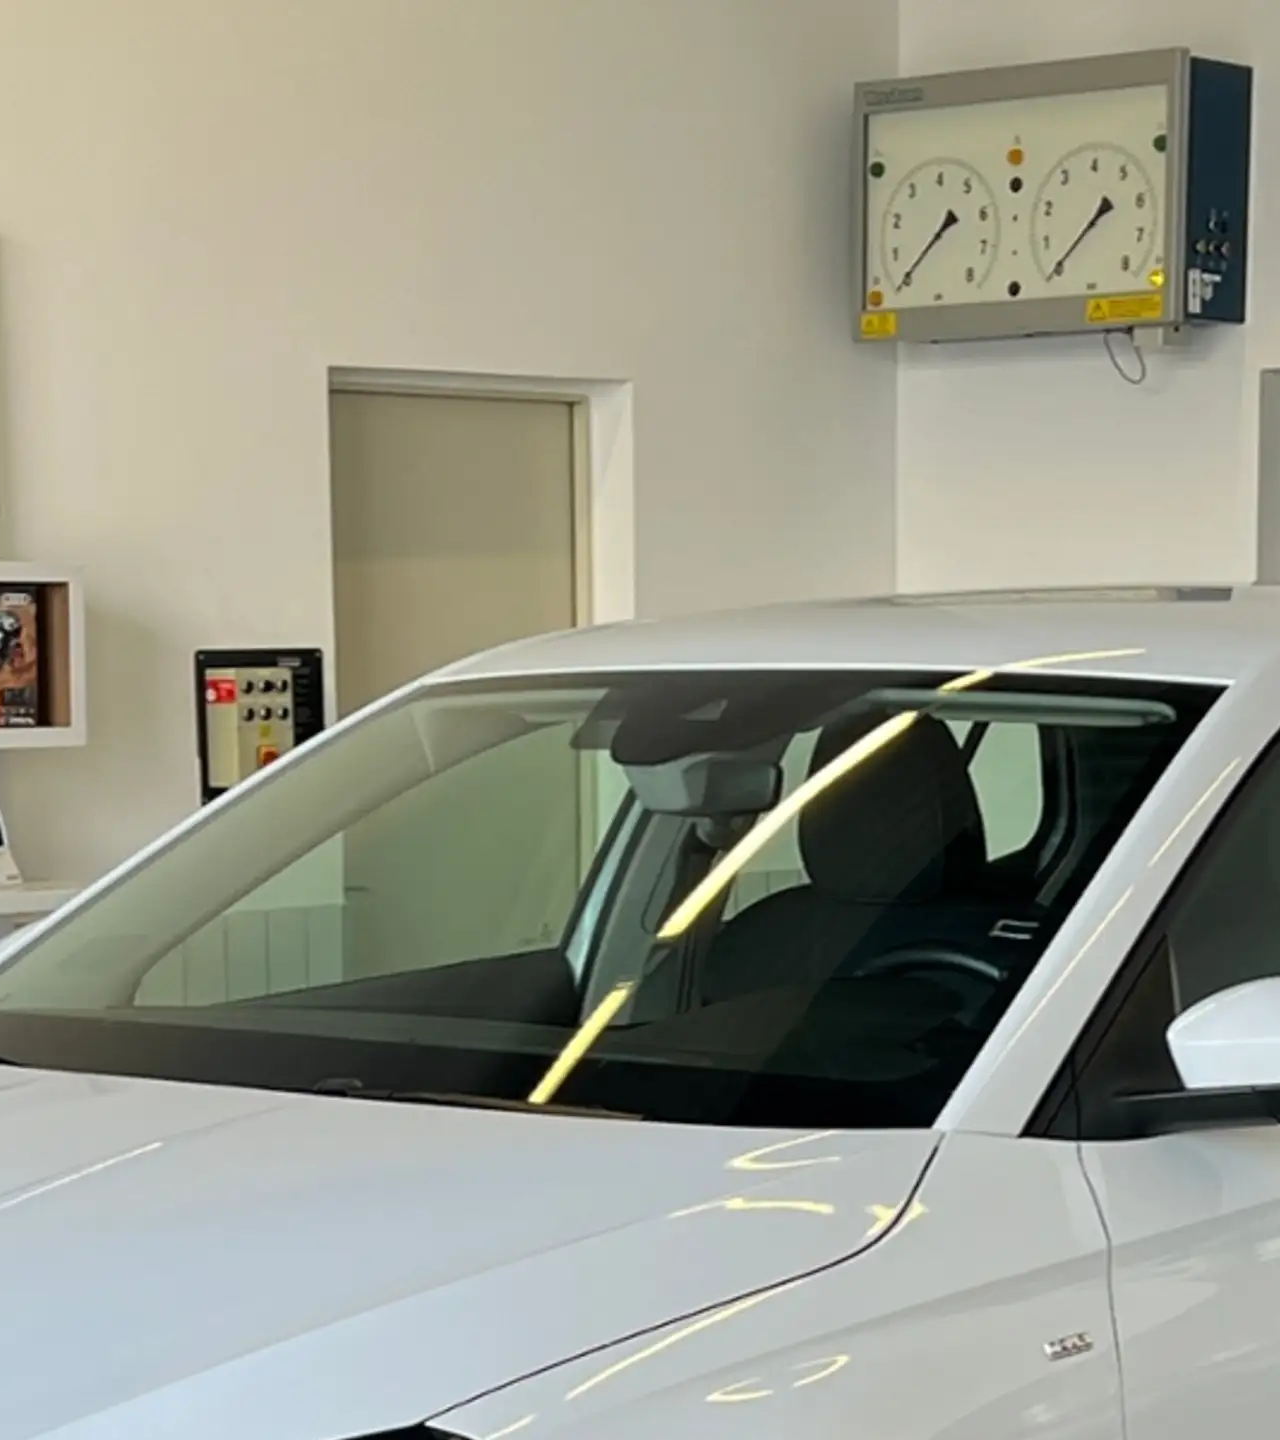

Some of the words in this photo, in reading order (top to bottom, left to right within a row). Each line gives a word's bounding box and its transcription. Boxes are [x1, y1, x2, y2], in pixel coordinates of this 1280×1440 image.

[1090, 157, 1098, 173] 4
[1119, 164, 1128, 181] 5
[935, 171, 944, 187] 4
[1060, 169, 1069, 186] 3
[908, 182, 917, 199] 3
[963, 178, 972, 194] 5
[1044, 200, 1054, 216] 2
[1135, 192, 1145, 208] 6
[893, 213, 902, 229] 2
[979, 206, 988, 221] 6
[1043, 235, 1050, 250] 1
[1135, 227, 1144, 243] 7
[892, 247, 899, 262] 1
[980, 238, 988, 255] 7
